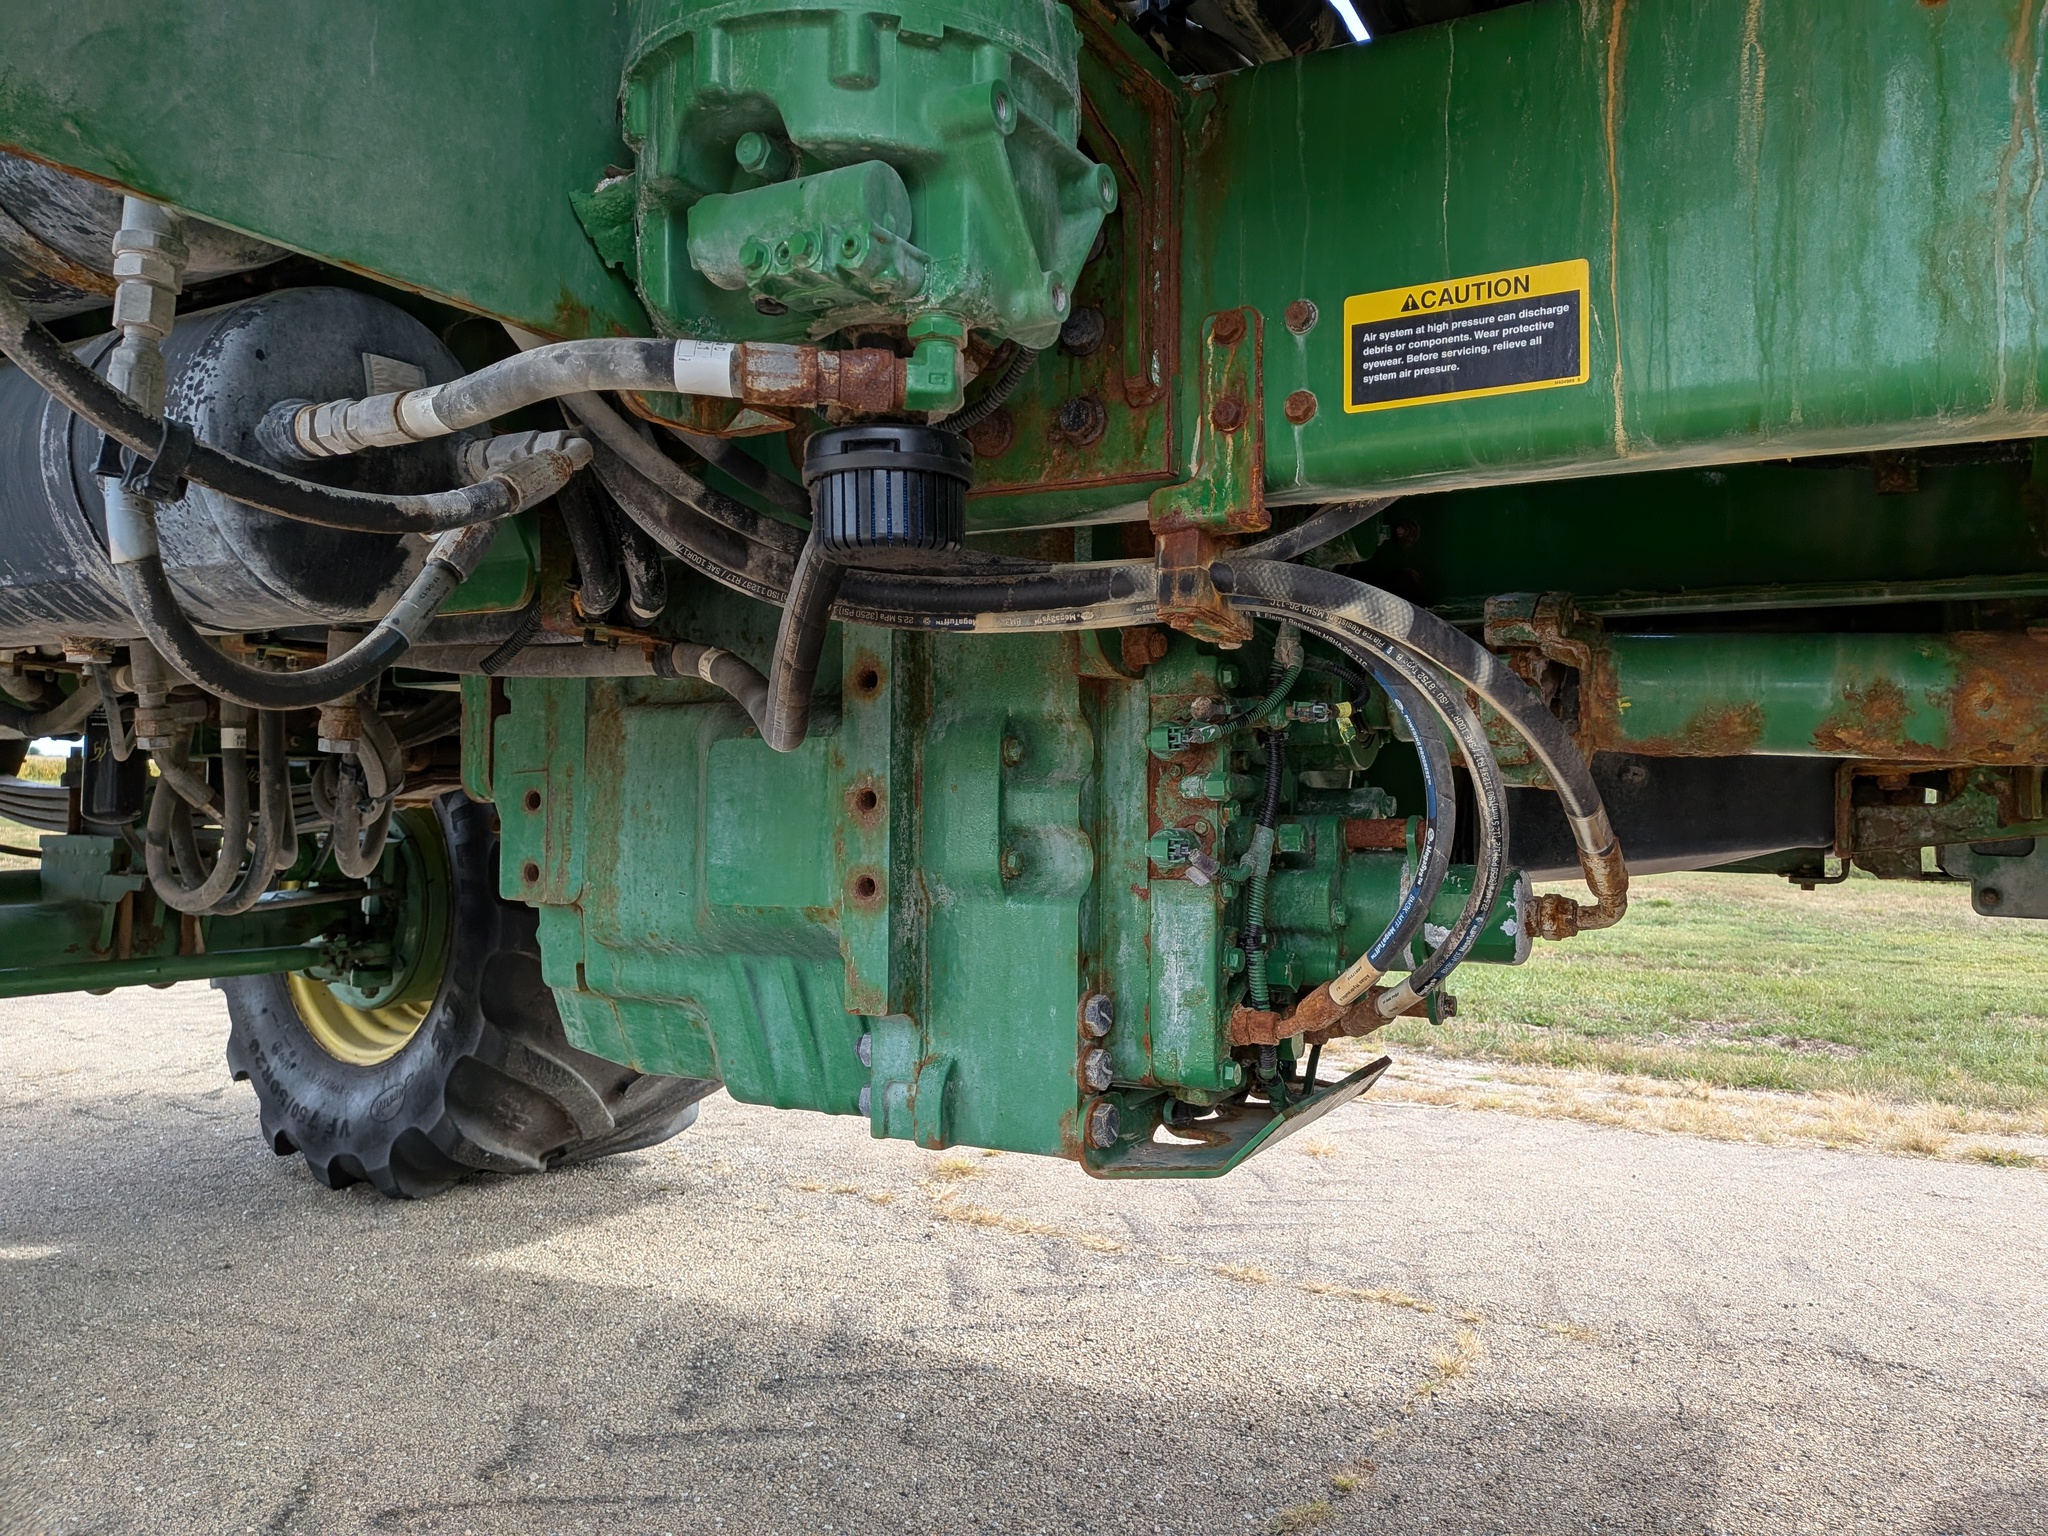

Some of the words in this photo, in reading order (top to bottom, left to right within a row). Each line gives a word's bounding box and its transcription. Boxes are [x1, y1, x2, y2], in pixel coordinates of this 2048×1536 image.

[1420, 274, 1530, 309] CAUTION
[1362, 332, 1377, 343] Air
[1379, 328, 1414, 341] system
[1415, 326, 1425, 335] at
[1427, 321, 1449, 334] high
[1451, 316, 1495, 331] pressure
[1497, 312, 1516, 323] can
[1518, 303, 1570, 319] discharge
[1362, 344, 1393, 356] debris
[1395, 342, 1406, 352] or
[1408, 333, 1473, 351] components.
[1474, 329, 1500, 340] Wear
[1502, 321, 1555, 338] protective
[1362, 357, 1404, 371] eyewear.
[1406, 351, 1439, 363] Before
[1441, 343, 1491, 360] servicing,
[1492, 339, 1527, 351] relieve
[1529, 336, 1542, 346] all
[1362, 370, 1397, 384] system
[1399, 368, 1411, 379] air
[1413, 362, 1460, 379] pressure.
[705, 562, 721, 576] SAE
[880, 613, 896, 622] MPa
[1301, 604, 1324, 618] MSHA
